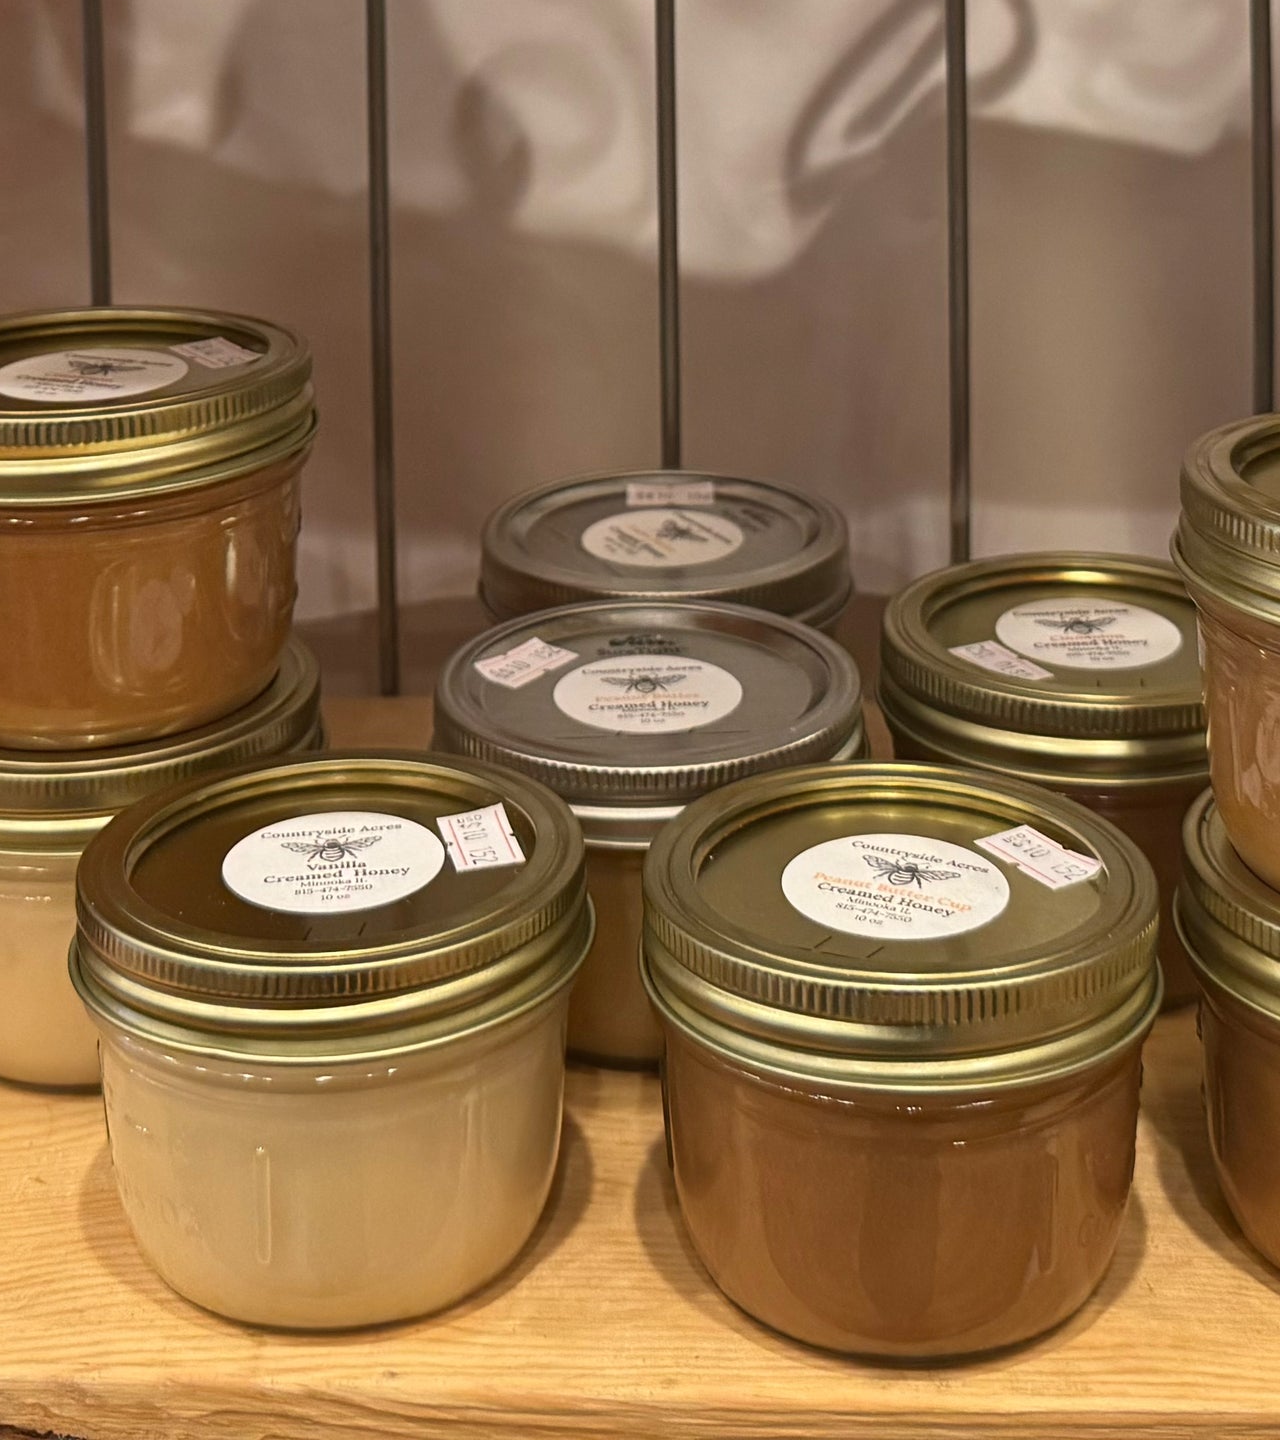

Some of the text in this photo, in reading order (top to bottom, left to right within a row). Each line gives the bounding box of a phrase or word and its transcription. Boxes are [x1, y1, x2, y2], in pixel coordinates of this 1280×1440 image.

[261, 823, 402, 839] Countryside Acres
[851, 840, 990, 874] Countryside Acres
[307, 861, 367, 871] Vanilla
[264, 866, 410, 883] Creamed Honey
[814, 872, 973, 913] Peanut Butter Cup
[817, 881, 955, 918] Creamed Honey
[847, 896, 897, 912] Minooka
[854, 913, 867, 922] 10
